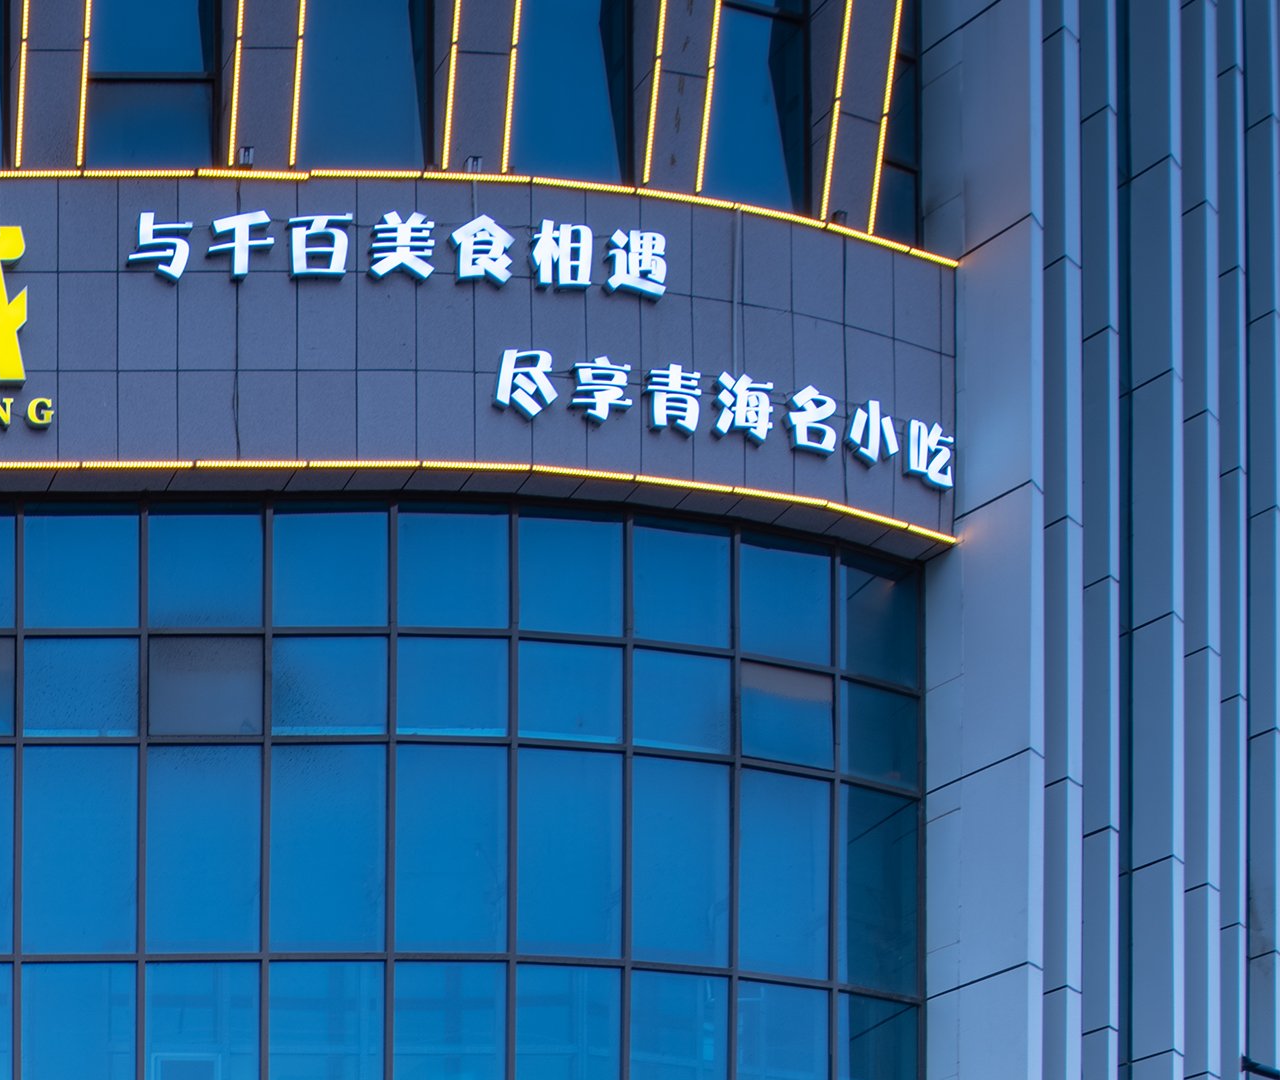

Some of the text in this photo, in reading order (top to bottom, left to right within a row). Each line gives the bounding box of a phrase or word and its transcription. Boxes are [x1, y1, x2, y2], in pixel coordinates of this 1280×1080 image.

[127, 209, 670, 301] 与千百美食相遇
[493, 347, 956, 491] 尽享青海名小吃
